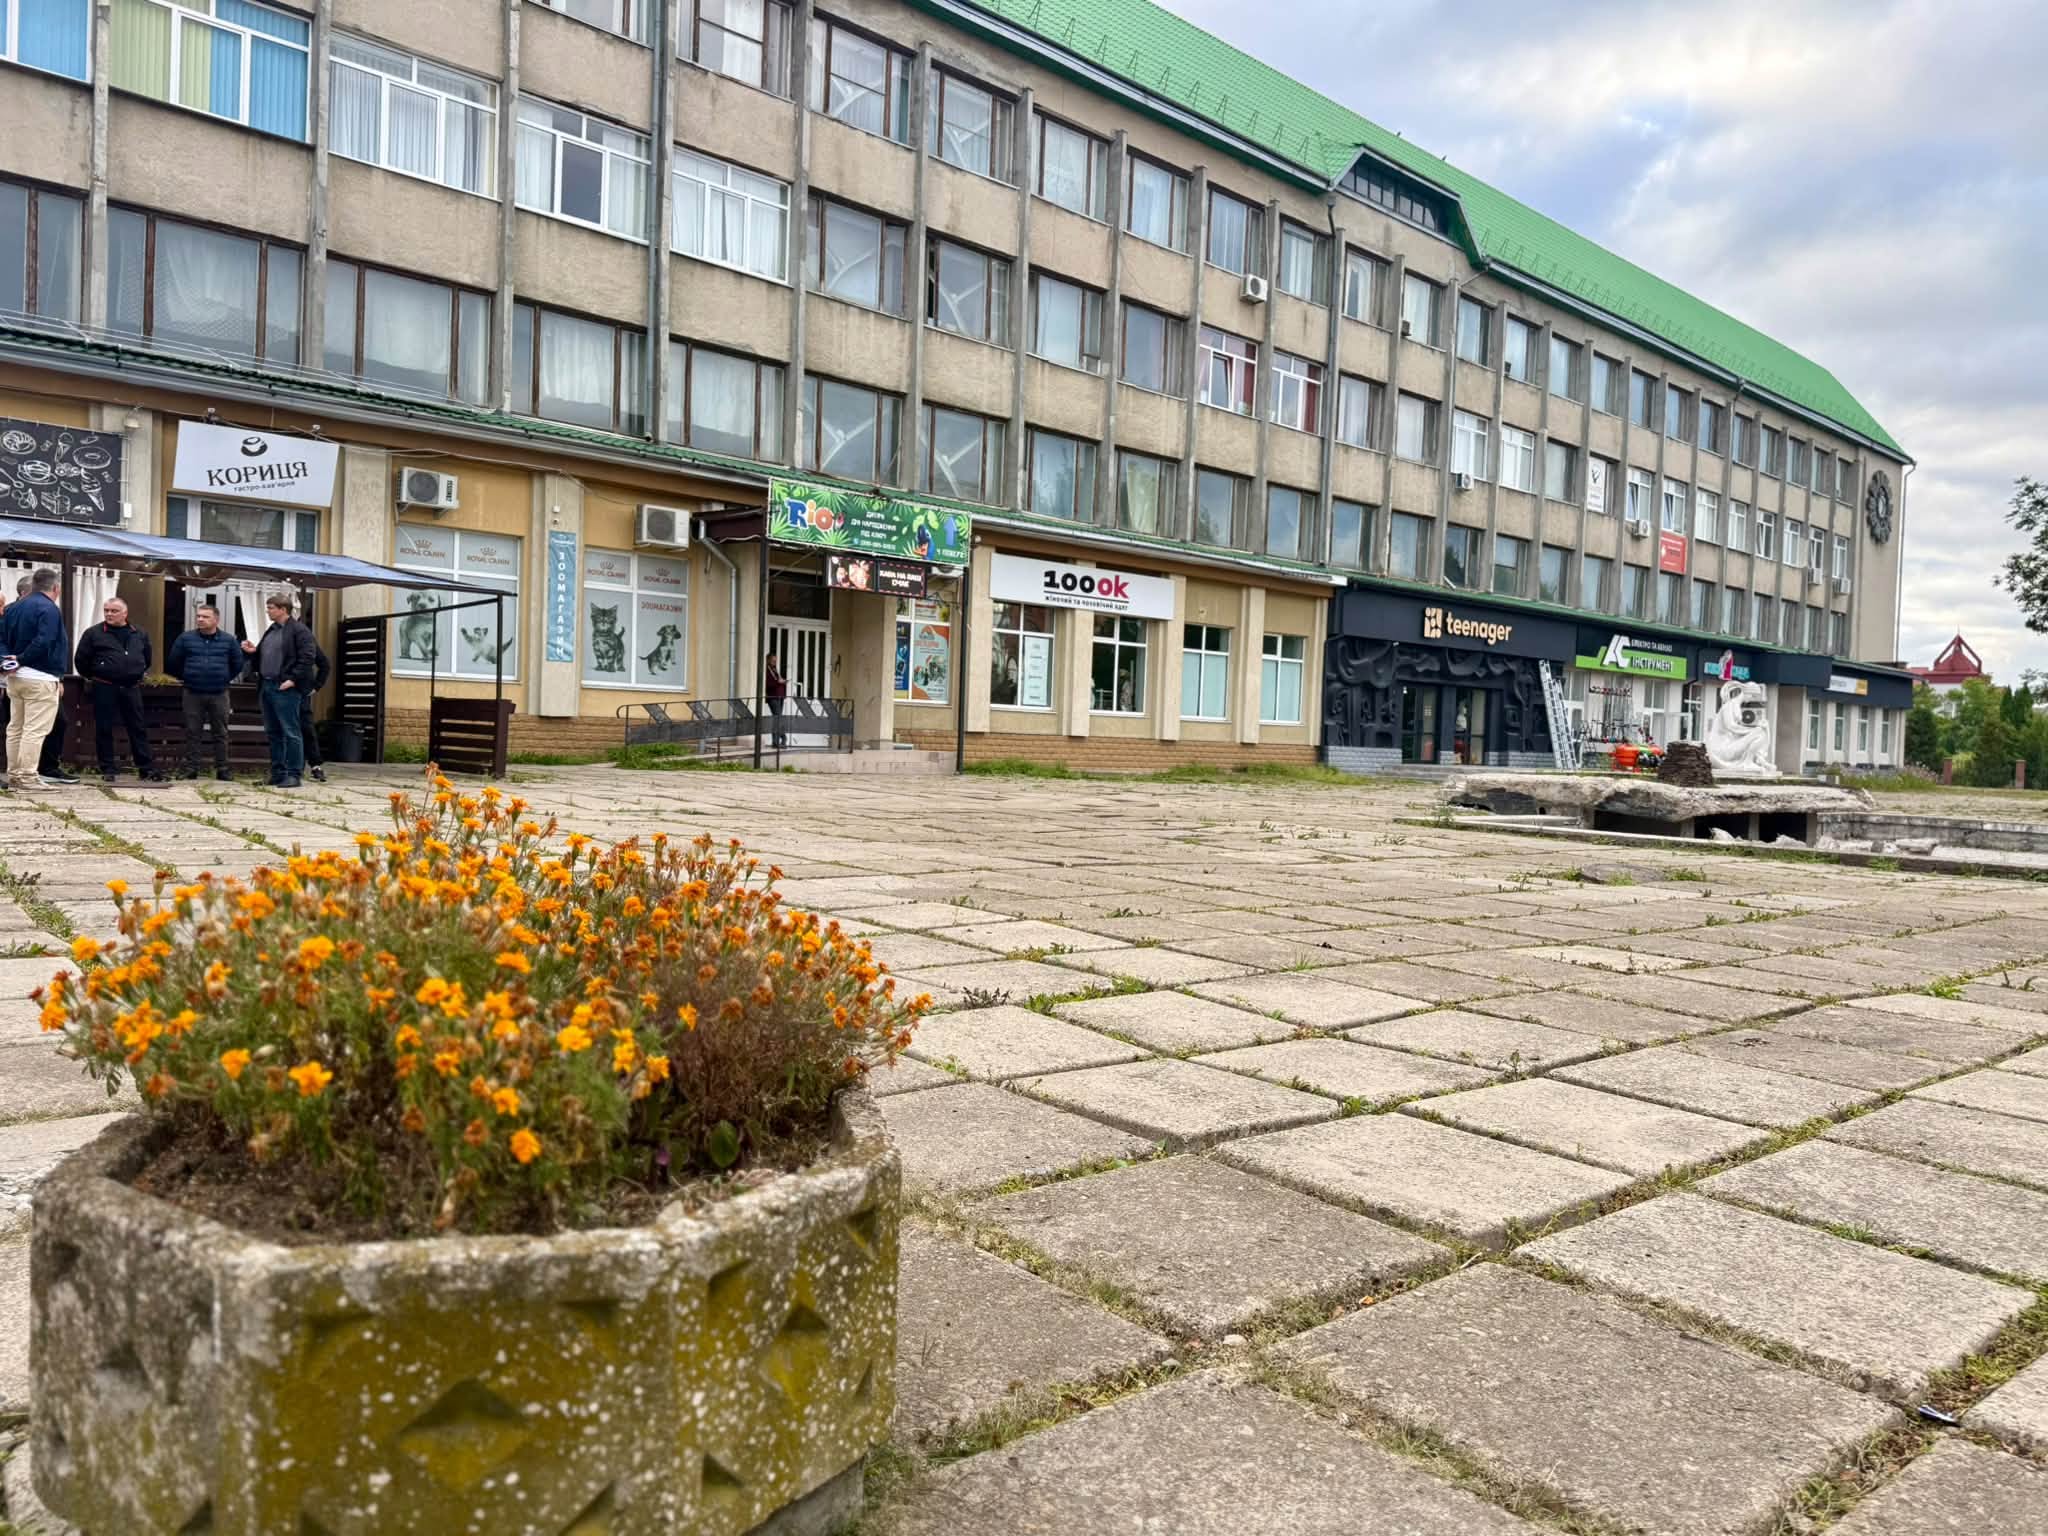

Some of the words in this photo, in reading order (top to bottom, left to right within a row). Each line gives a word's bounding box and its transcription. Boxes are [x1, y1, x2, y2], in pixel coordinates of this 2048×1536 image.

[206, 461, 309, 487] КОРИЦЯ
[862, 520, 897, 531] НАРОДЖЕННЯ
[400, 547, 421, 556] ROYAL
[422, 550, 446, 558] CANIN
[466, 555, 487, 563] ROYAL
[488, 557, 510, 566] CANIN
[557, 551, 566, 657] ЗООМАГАЗИН
[1446, 611, 1512, 645] teenager
[1631, 655, 1673, 673] ІНСТРУМЕНТ
